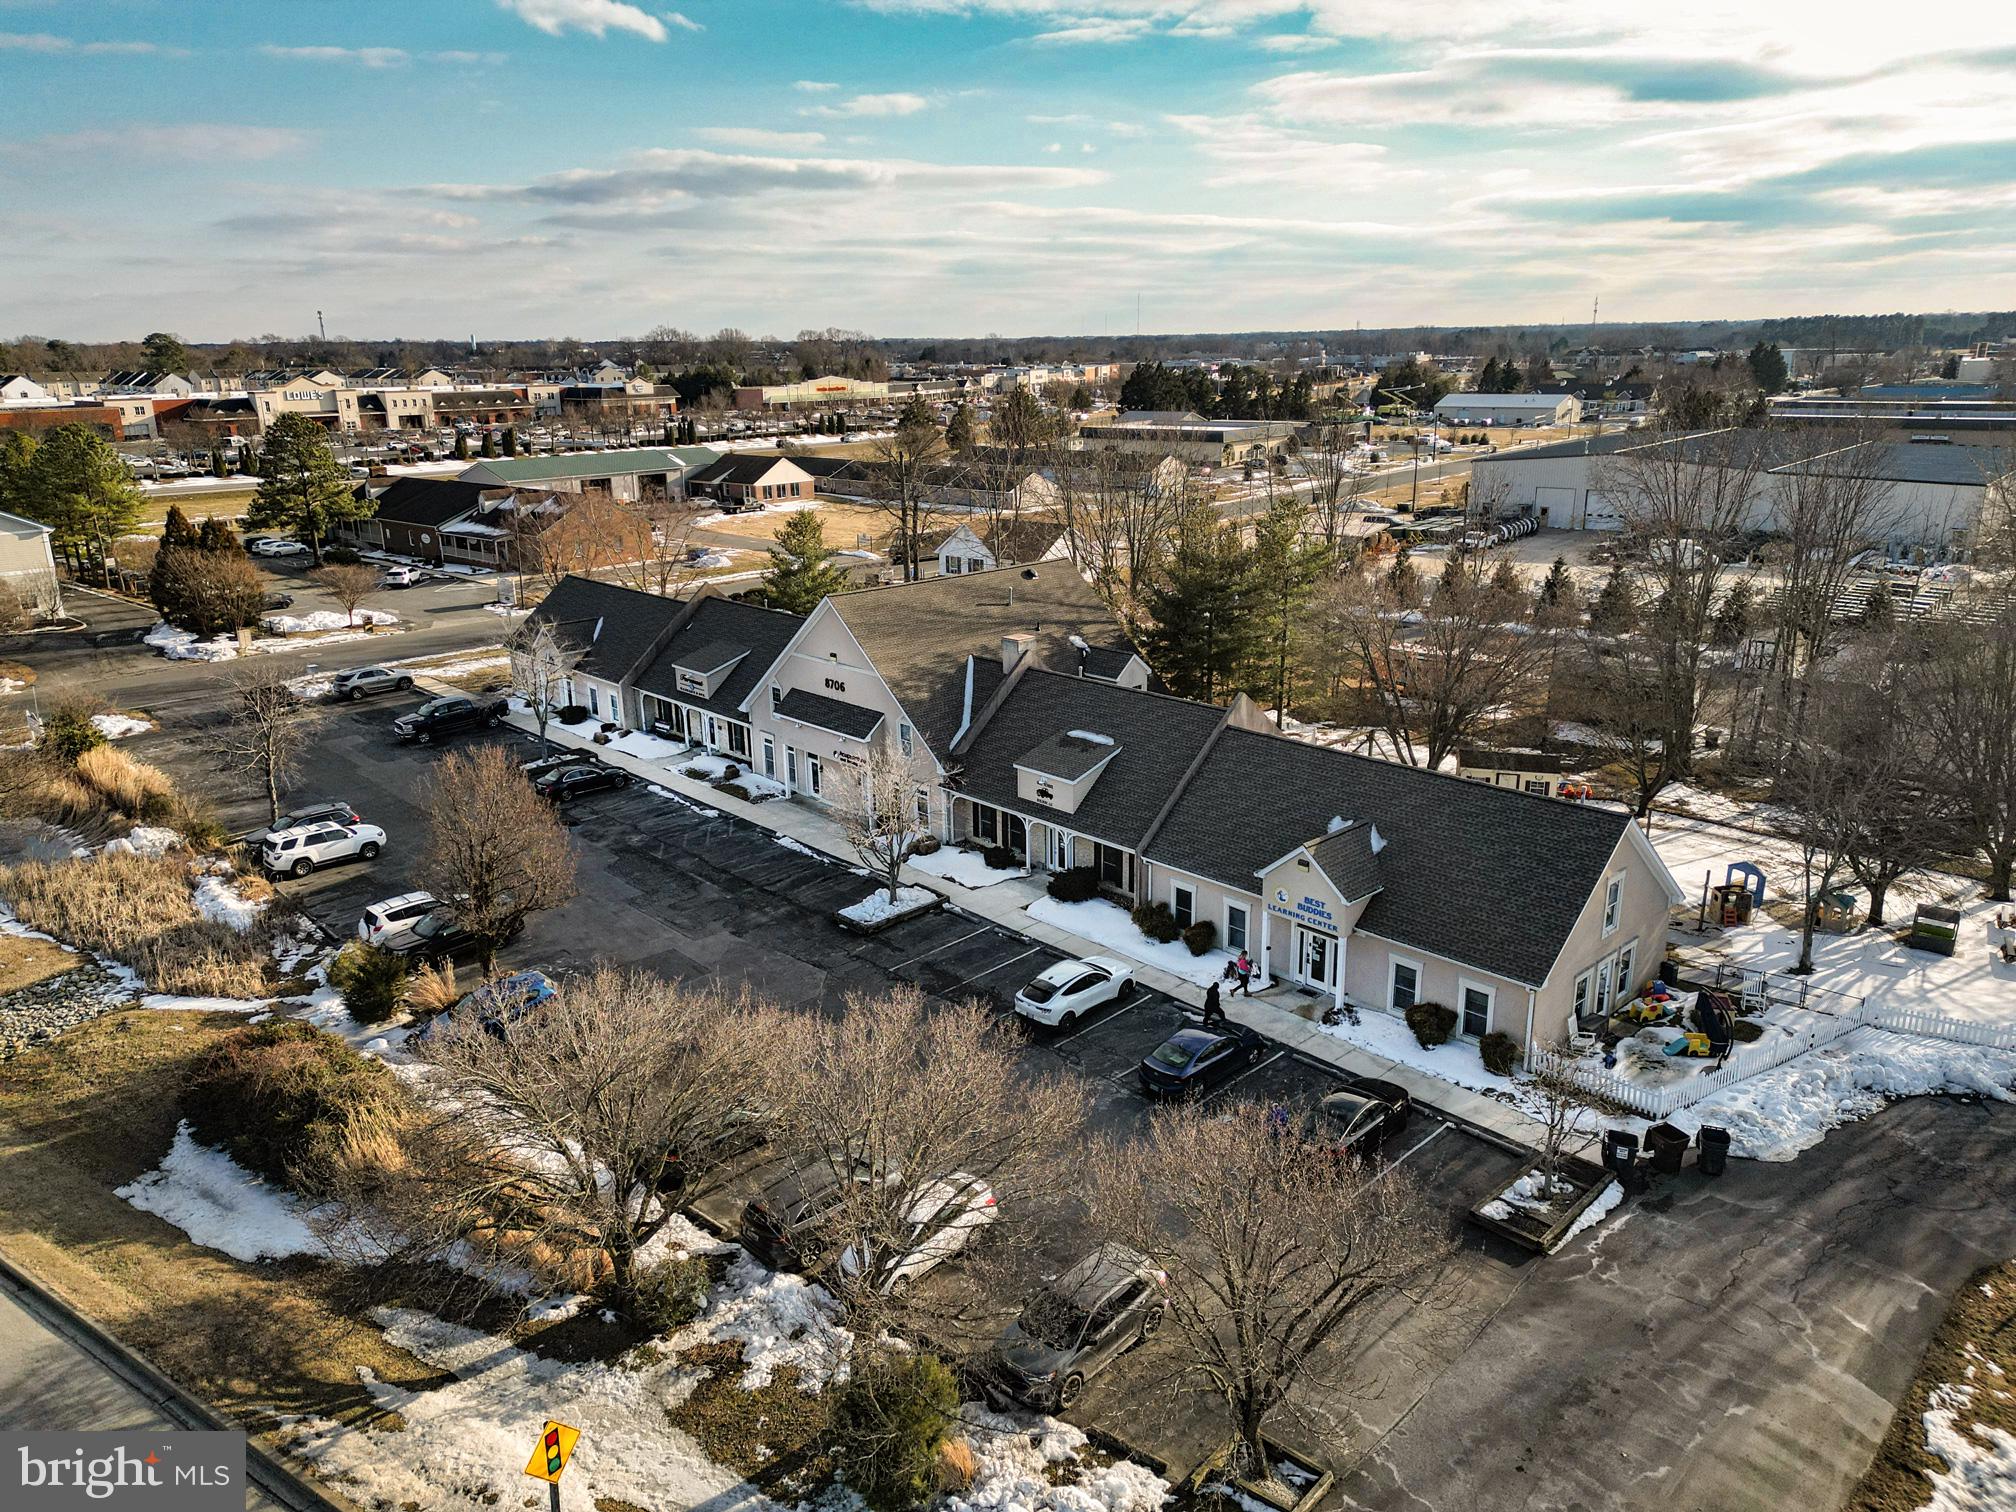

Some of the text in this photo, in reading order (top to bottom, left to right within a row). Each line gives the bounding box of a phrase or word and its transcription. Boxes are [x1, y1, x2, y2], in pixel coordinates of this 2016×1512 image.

[286, 390, 324, 400] LOWE'S
[824, 677, 846, 693] 8706
[1303, 896, 1326, 909] BEST
[1267, 903, 1338, 933] LEARNING CENTER
[1297, 902, 1333, 920] BUDDIES
